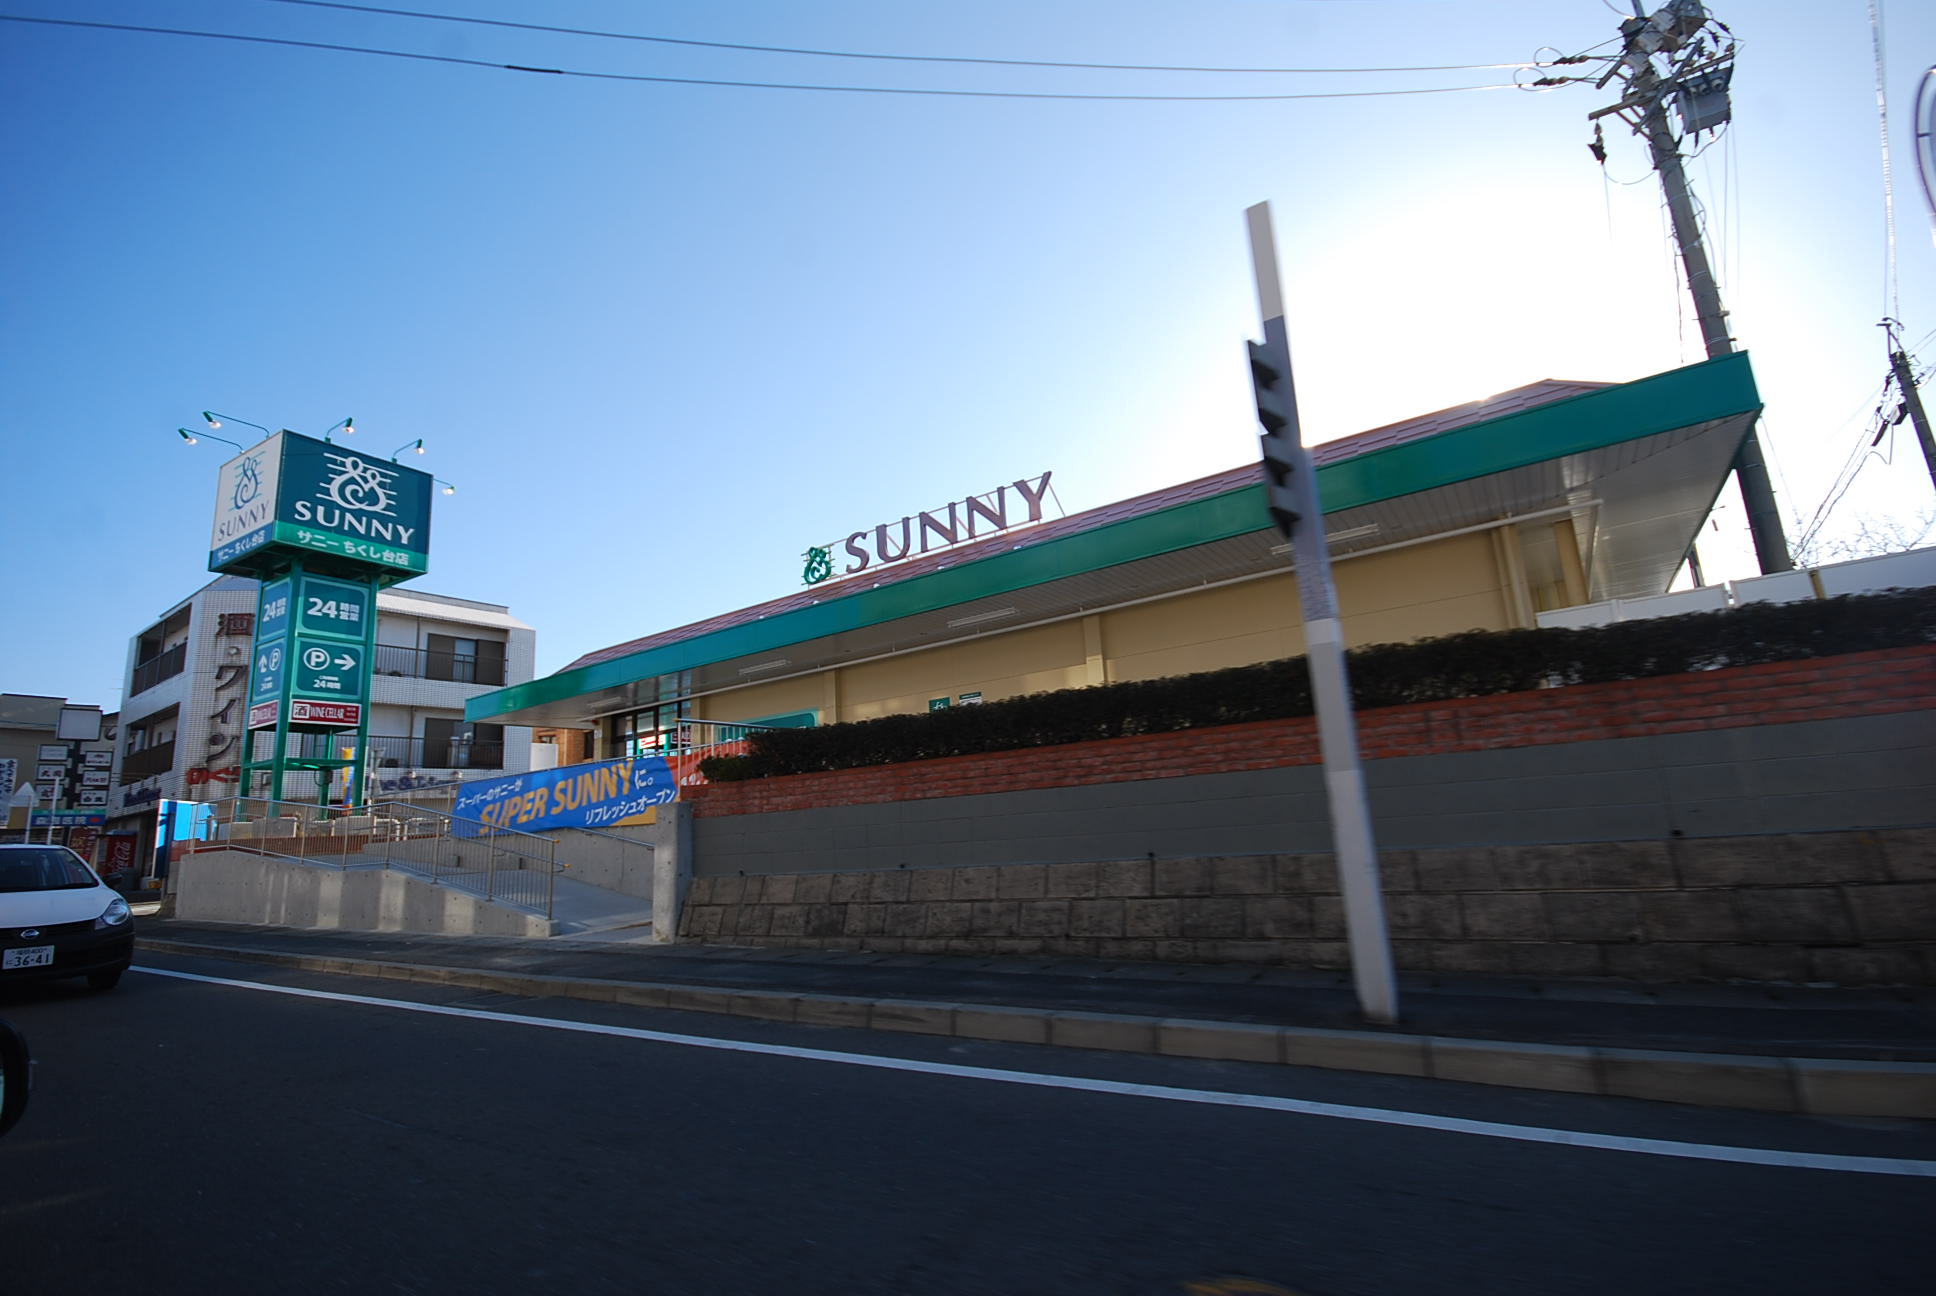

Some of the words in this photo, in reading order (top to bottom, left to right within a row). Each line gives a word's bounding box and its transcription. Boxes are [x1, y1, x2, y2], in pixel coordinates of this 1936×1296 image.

[218, 501, 269, 541] SUNNY
[294, 500, 415, 545] SUNNY
[845, 471, 1052, 574] SUNNY
[297, 529, 339, 549] サニー
[343, 540, 409, 566] ちくし台店
[262, 601, 276, 622] 24
[307, 597, 337, 618] 24
[313, 679, 326, 688] 24
[310, 706, 325, 718] WINE
[325, 707, 344, 719] CELLAR
[457, 778, 523, 810] スーパーのサニーが
[479, 786, 549, 835] SUPER
[551, 759, 633, 815] SUNNY
[586, 788, 676, 825] リフレッシュオープン
